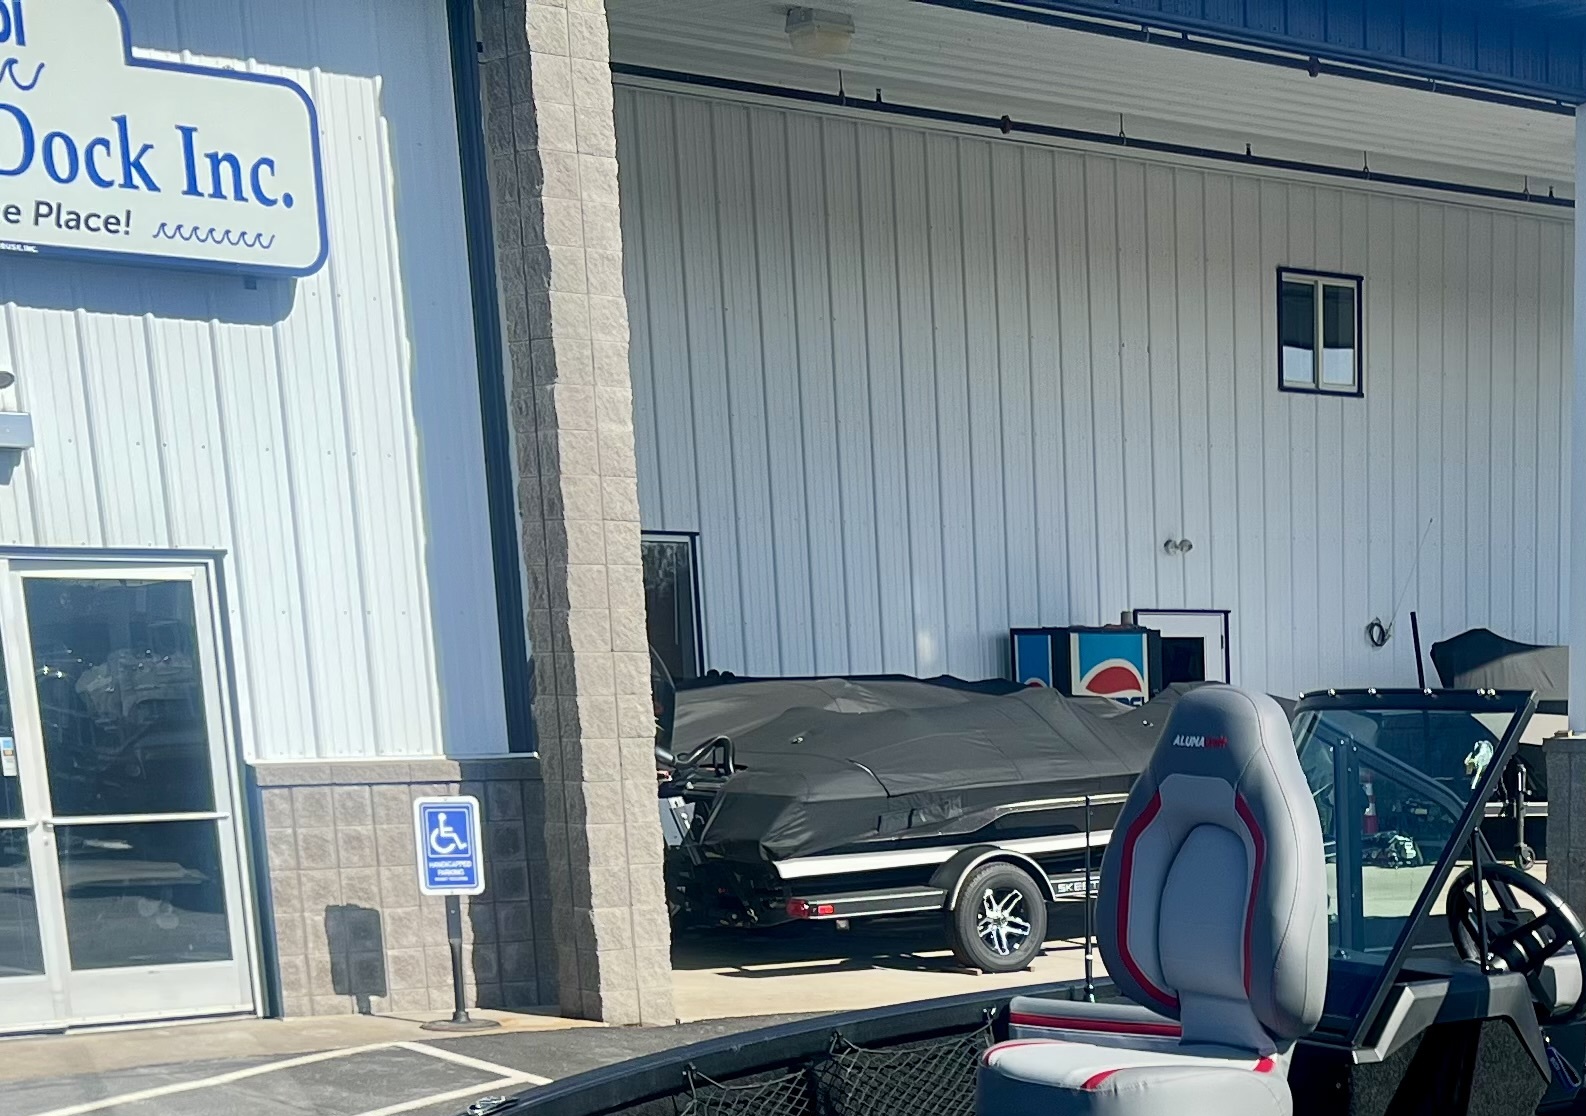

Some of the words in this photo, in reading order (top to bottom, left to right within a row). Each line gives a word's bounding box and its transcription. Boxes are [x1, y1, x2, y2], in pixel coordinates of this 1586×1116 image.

[0, 103, 161, 192] Dock
[175, 124, 294, 209] Inc.
[33, 200, 132, 236] Place!
